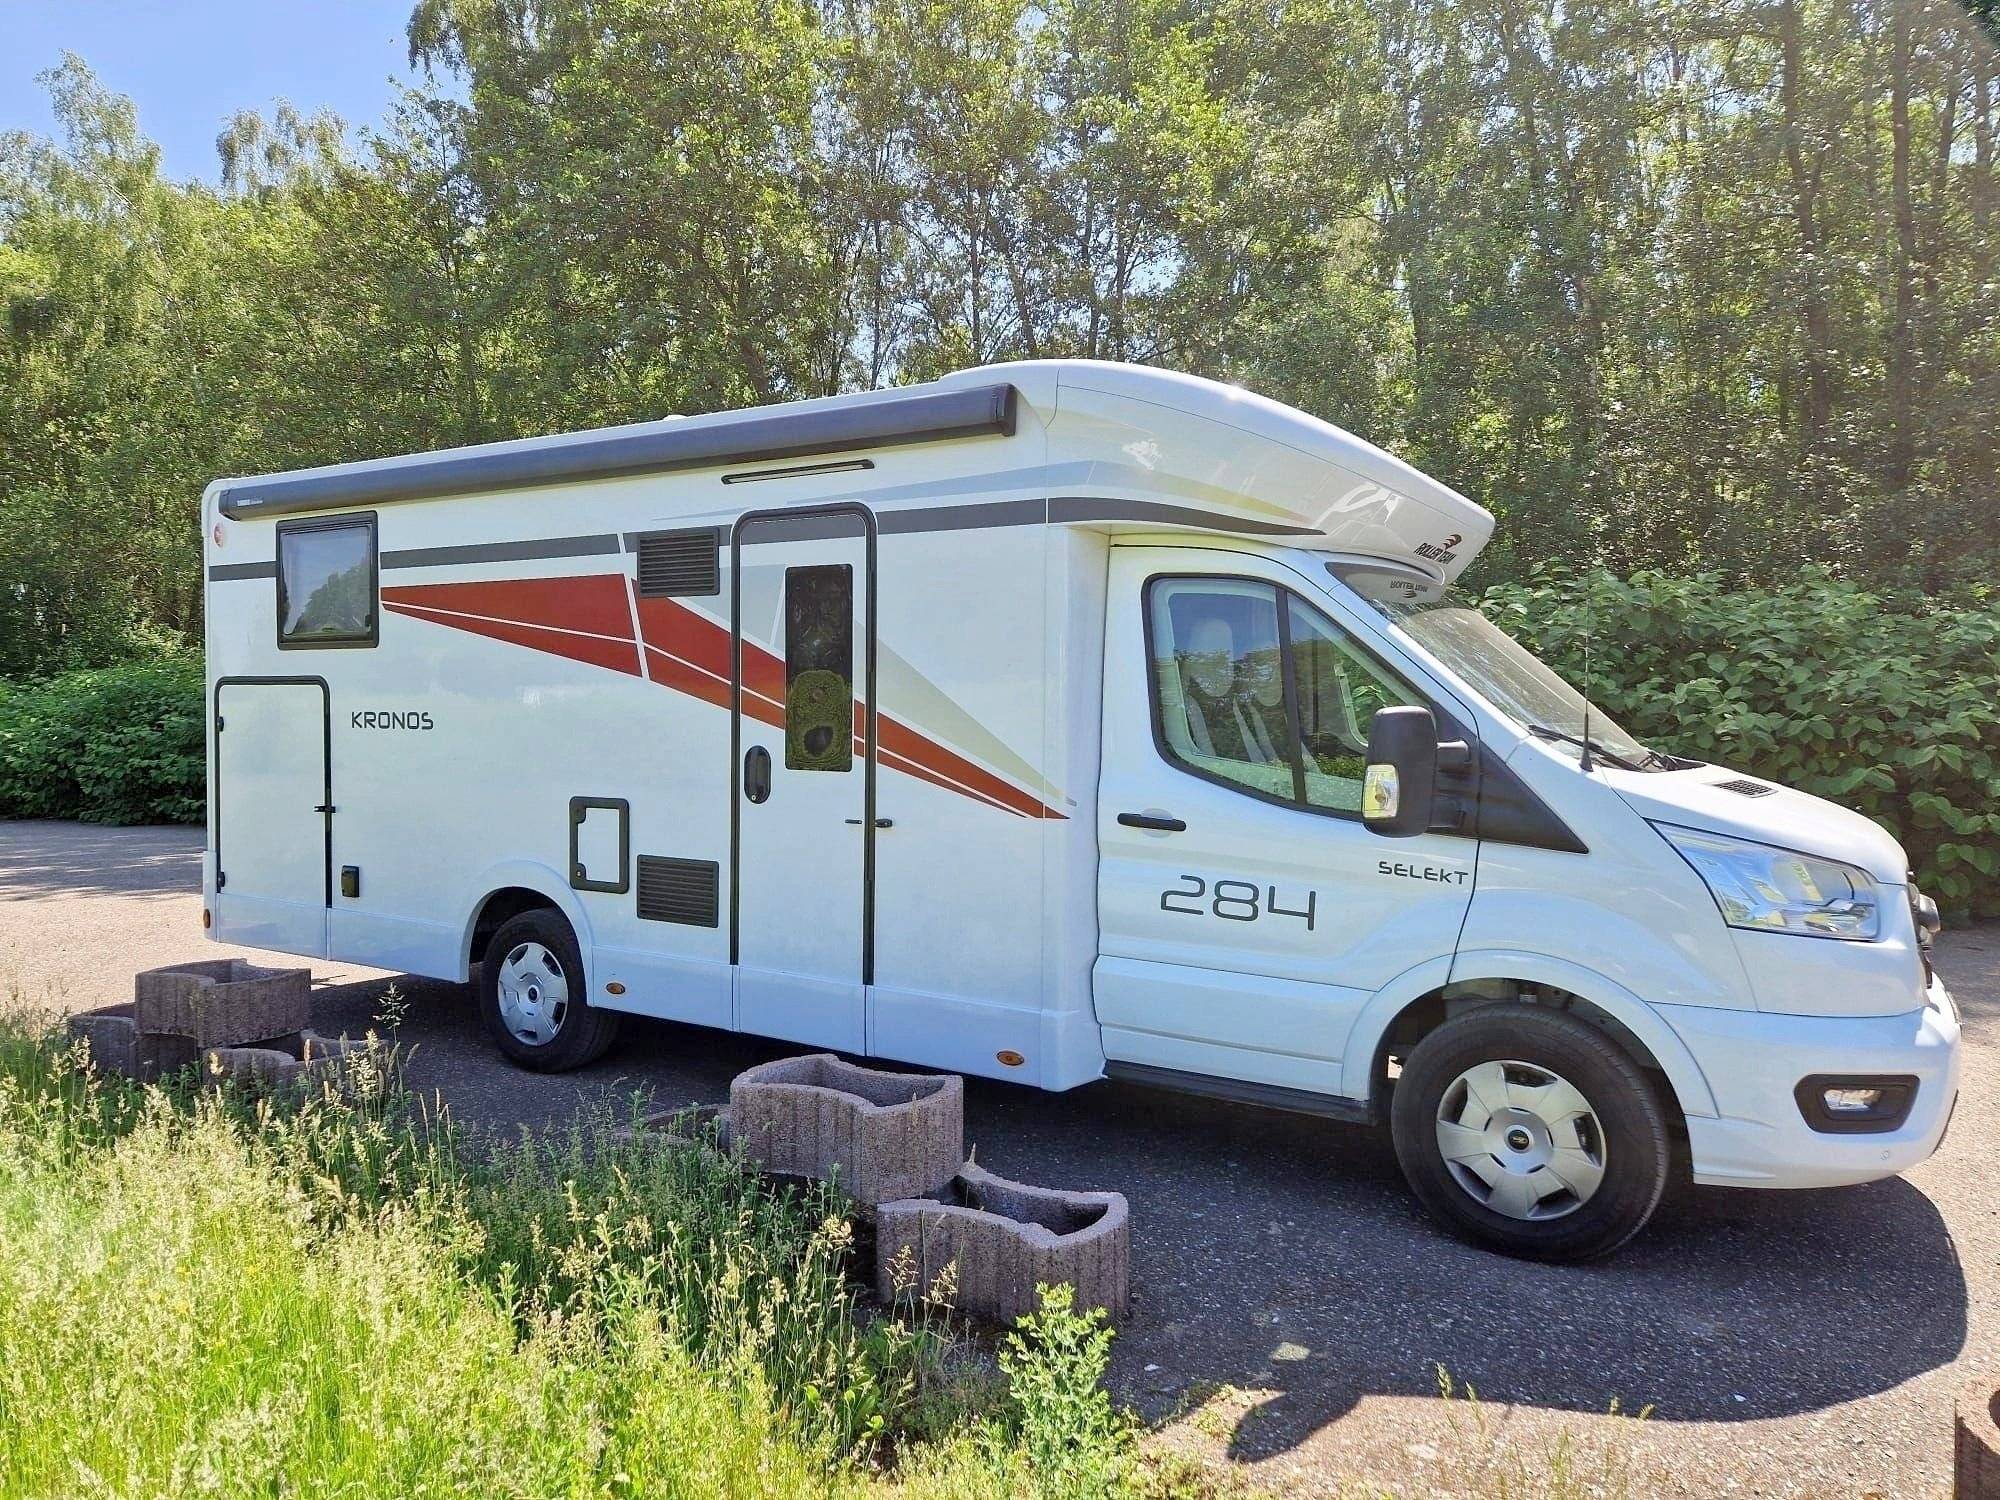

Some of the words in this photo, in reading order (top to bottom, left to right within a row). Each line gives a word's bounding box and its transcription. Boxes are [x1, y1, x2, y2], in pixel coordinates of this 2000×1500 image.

[1413, 542, 1443, 561] ROLLER
[351, 711, 434, 730] KRONOS
[1378, 861, 1469, 885] SELEKT
[1160, 874, 1316, 931] 284
